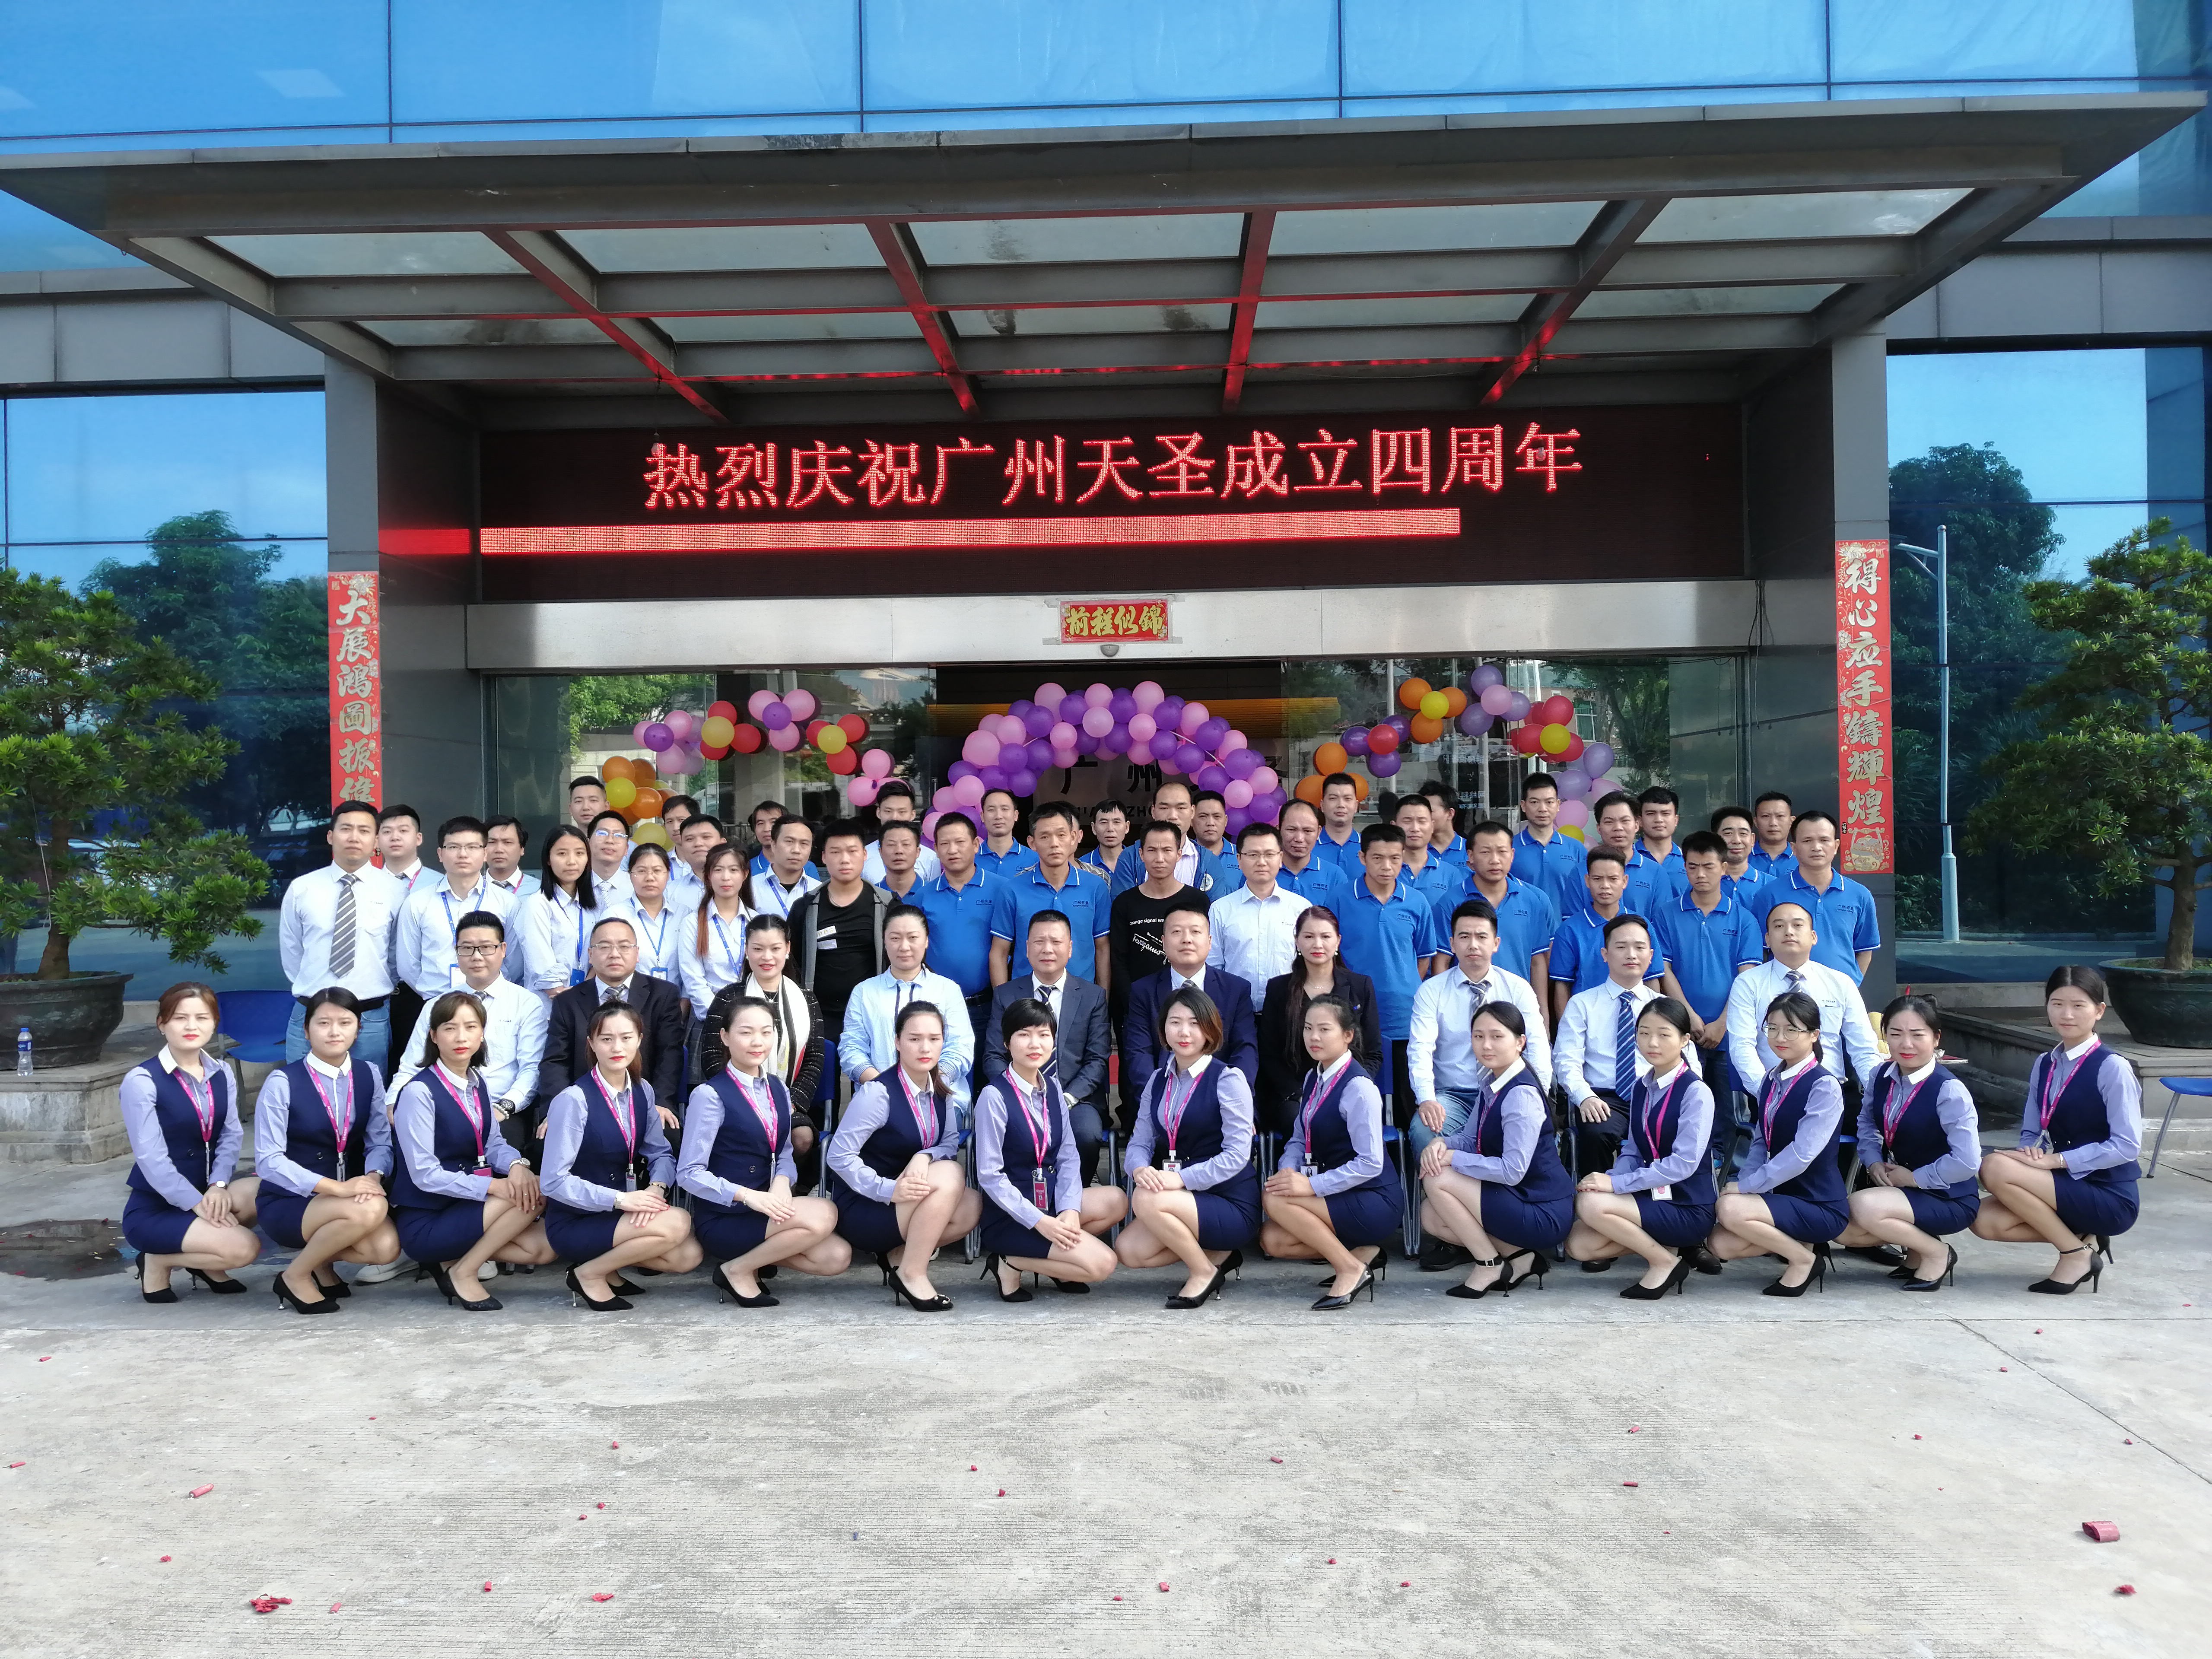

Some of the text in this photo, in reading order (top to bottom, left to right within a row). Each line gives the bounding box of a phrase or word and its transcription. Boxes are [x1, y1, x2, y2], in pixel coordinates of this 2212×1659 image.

[642, 422, 1583, 509] 热烈庆祝广州天圣成立四周年
